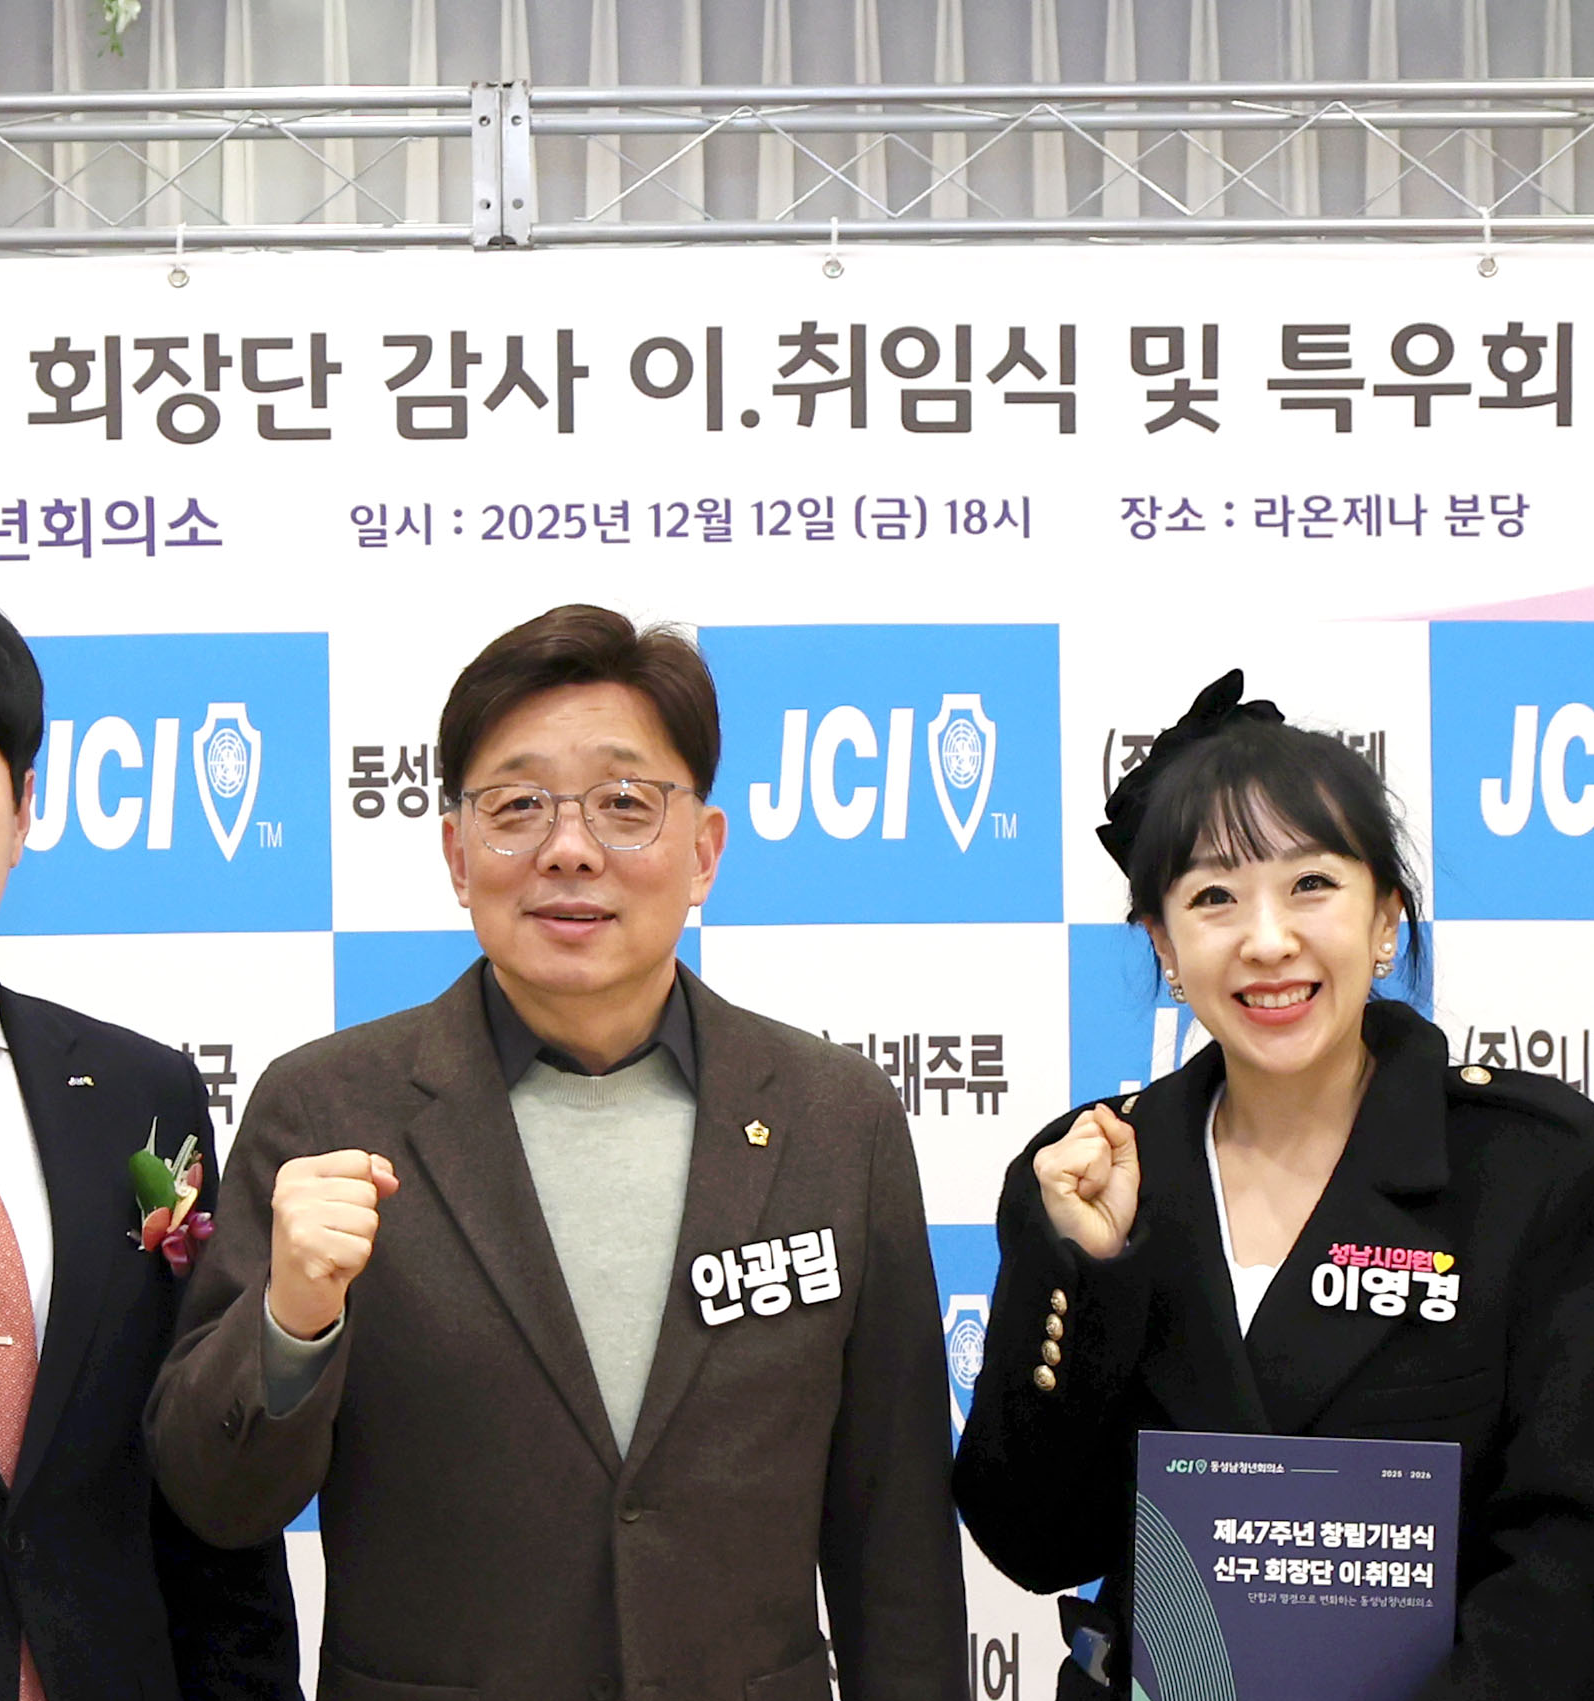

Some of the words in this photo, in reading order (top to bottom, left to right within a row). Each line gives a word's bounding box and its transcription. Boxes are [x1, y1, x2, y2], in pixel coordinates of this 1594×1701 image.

[28, 333, 342, 445] 회장단
[383, 329, 589, 440] 감사
[630, 321, 1078, 435] 이.취임식
[1130, 324, 1220, 434] 및
[1267, 322, 1573, 433] 특우회
[350, 502, 432, 548] 일시
[481, 499, 631, 544] 2025년
[648, 497, 733, 543] 12월
[751, 496, 834, 541] 12일
[854, 495, 927, 541] (금)
[944, 496, 1031, 539] 18시
[1120, 495, 1206, 541] 장소
[1254, 494, 1428, 539] 라온제나
[1444, 494, 1530, 538] 분당
[23, 715, 180, 852] JCI
[256, 821, 283, 848] TM
[348, 743, 453, 819] 동성
[749, 705, 915, 841] JCI
[991, 812, 1017, 839] TM
[691, 1227, 841, 1327] 안광림
[1328, 1243, 1433, 1272] 성남시의원
[1312, 1263, 1460, 1322] 이영경
[1166, 1459, 1194, 1473] JCI
[1210, 1461, 1285, 1474] 동성남청년회의소
[1213, 1518, 1315, 1546] 제47주년
[1320, 1521, 1435, 1551] 창립기념식
[1213, 1556, 1259, 1583] 신구
[1264, 1558, 1335, 1586] 회장단
